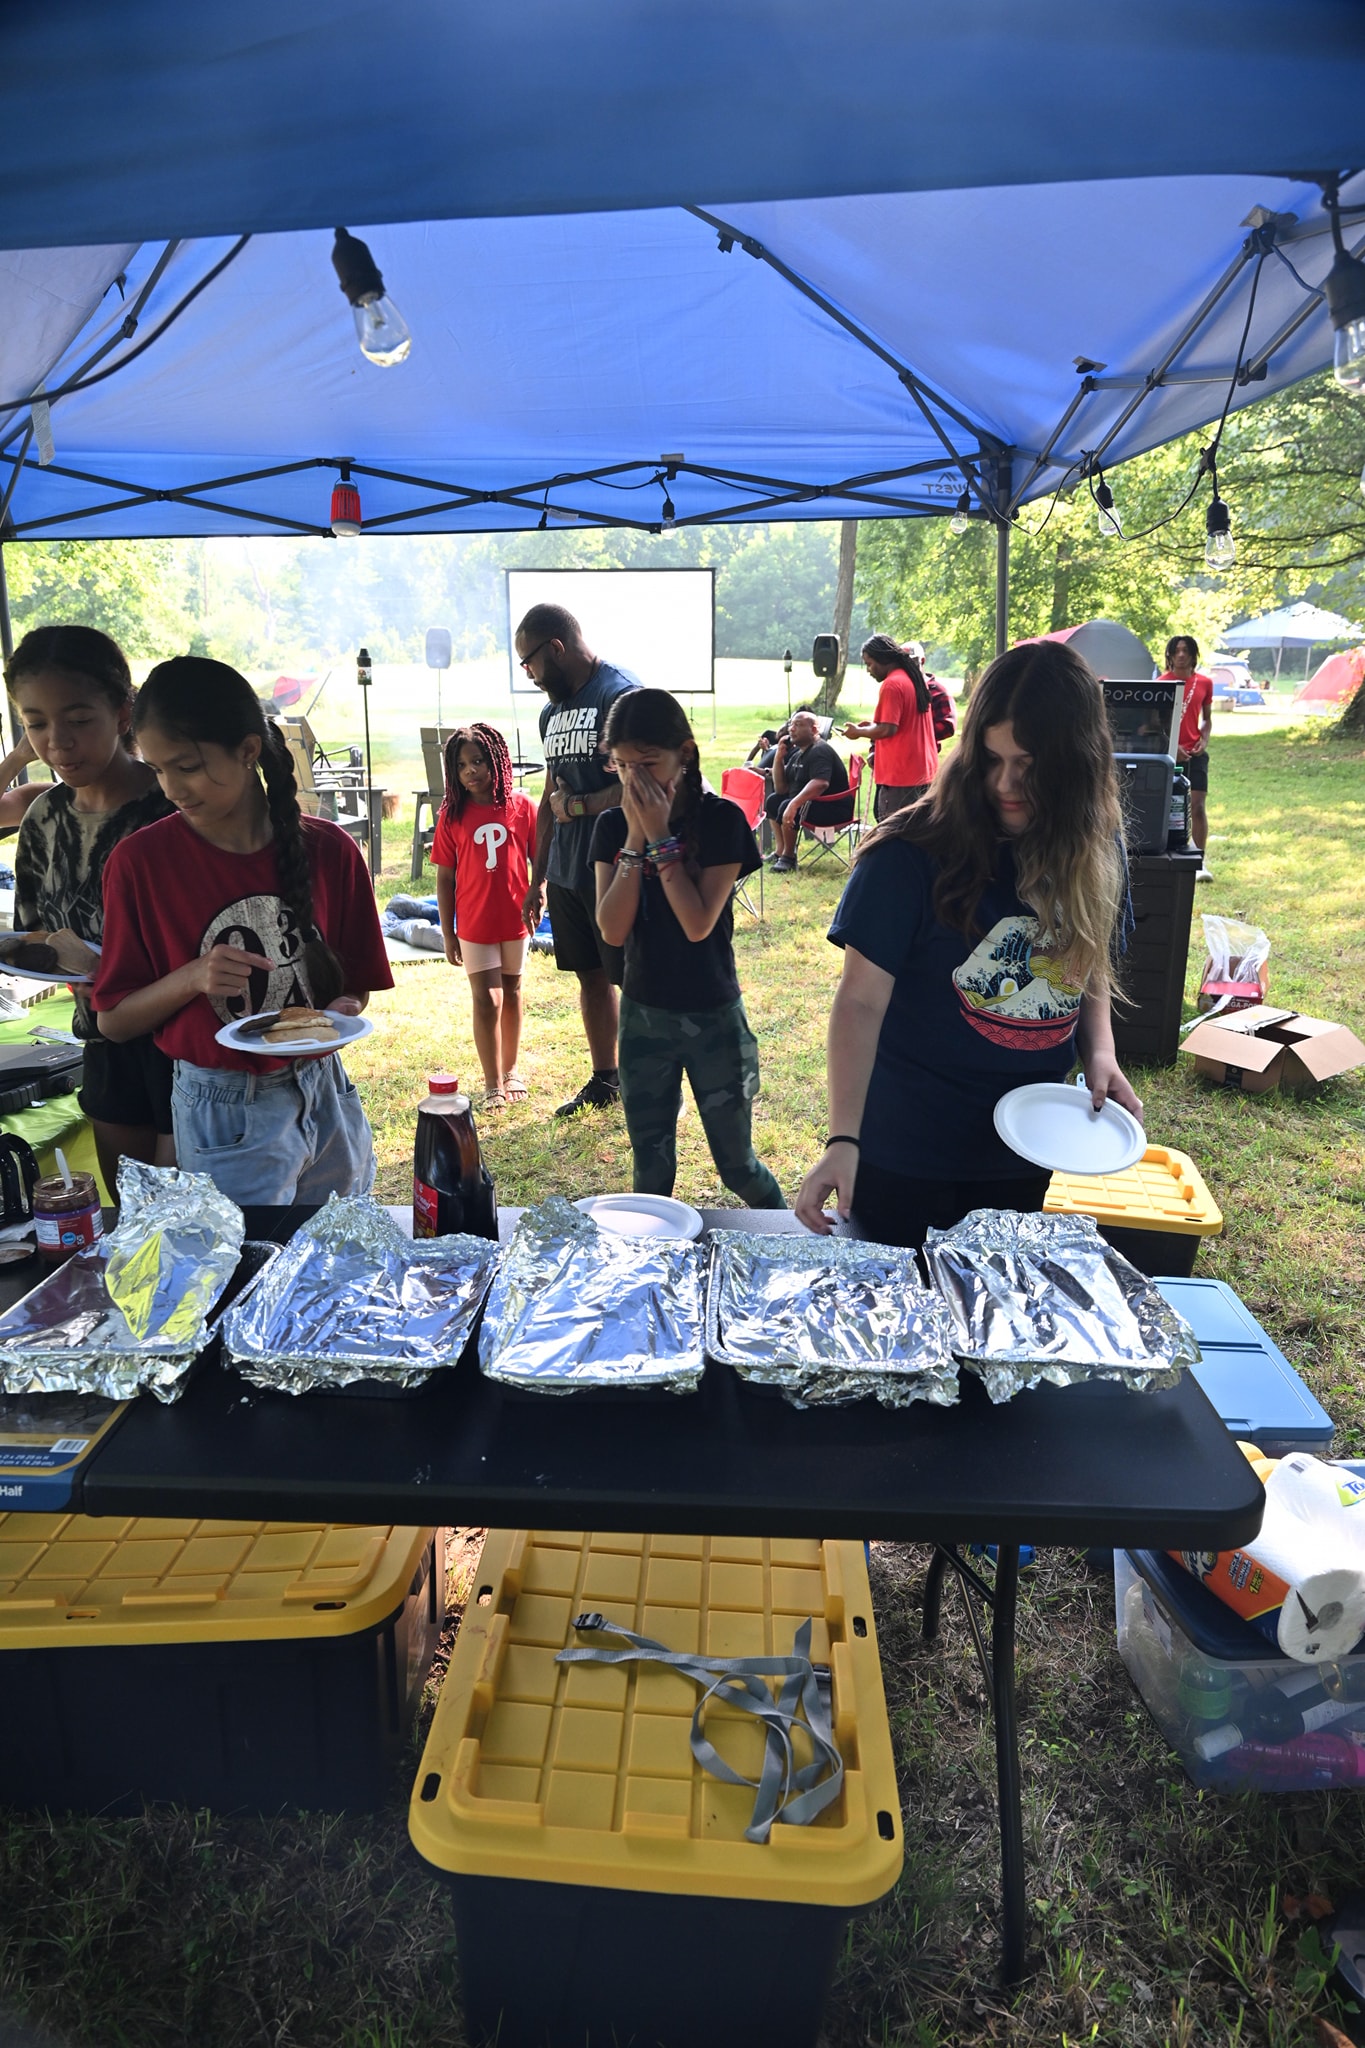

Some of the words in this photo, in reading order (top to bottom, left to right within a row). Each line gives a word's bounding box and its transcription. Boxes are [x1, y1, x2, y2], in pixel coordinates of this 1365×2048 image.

[1104, 689, 1174, 702] POPCORN
[473, 822, 508, 870] P
[0, 1485, 23, 1496] Half
